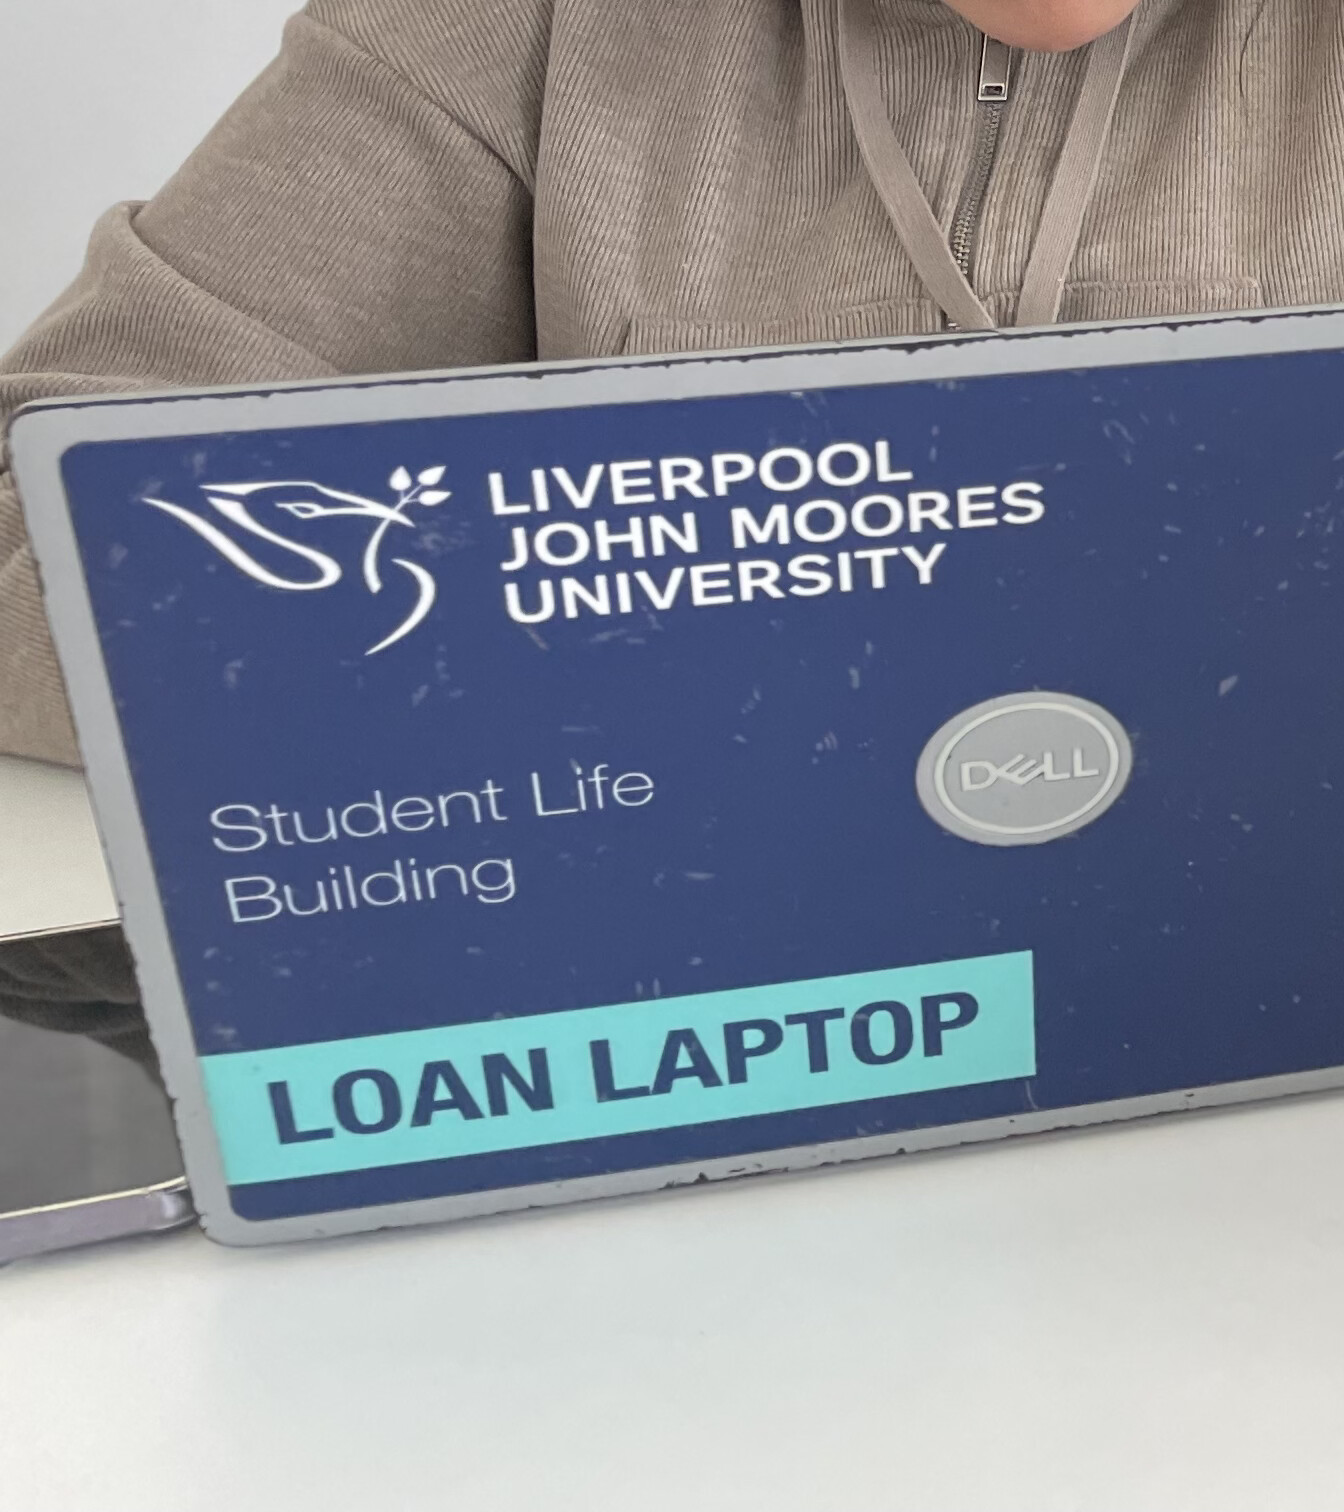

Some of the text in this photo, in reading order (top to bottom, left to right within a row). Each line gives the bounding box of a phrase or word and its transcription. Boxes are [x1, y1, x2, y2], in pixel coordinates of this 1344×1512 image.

[490, 439, 913, 516] LIVERPOOL
[500, 482, 1046, 572] JOHN MOORES
[505, 543, 948, 625] UNIVERSITY
[210, 763, 656, 854] Student Life
[960, 746, 1100, 794] DELL
[223, 850, 518, 924] Building
[268, 990, 981, 1146] LOAN LAPTOP
